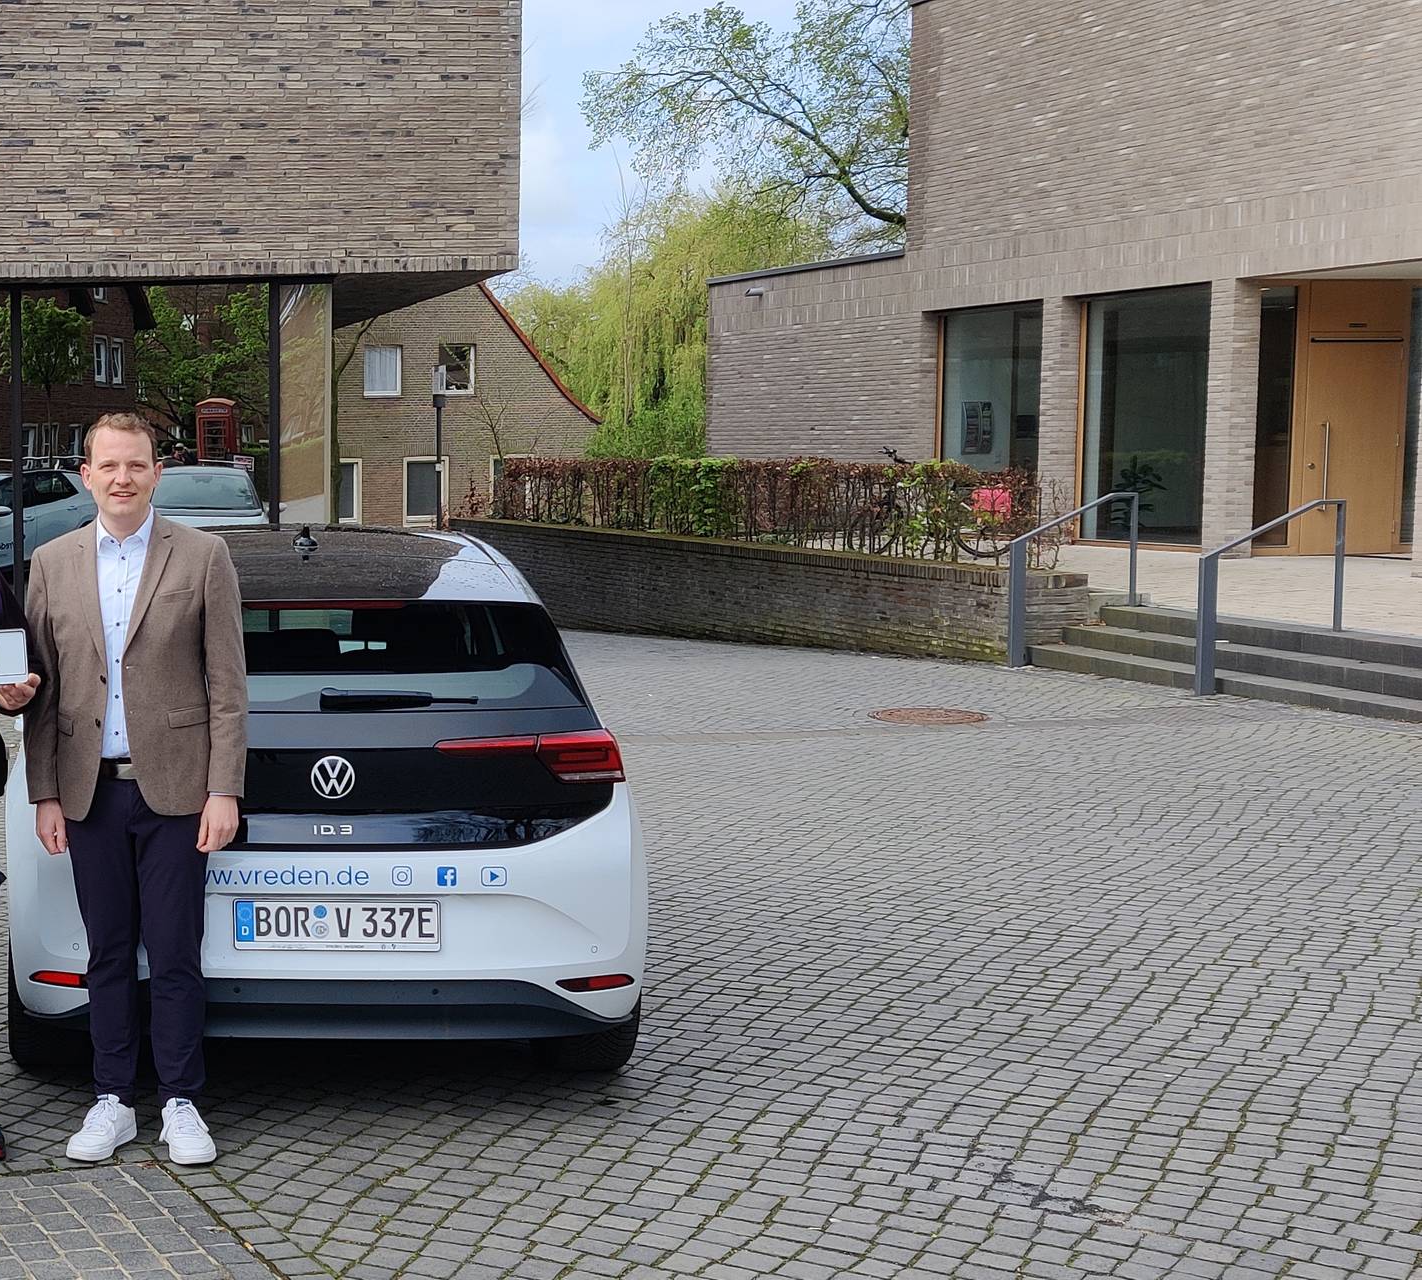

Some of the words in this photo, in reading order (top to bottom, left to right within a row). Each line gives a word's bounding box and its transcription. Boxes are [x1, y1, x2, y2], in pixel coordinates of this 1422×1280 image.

[241, 925, 250, 936] D
[255, 906, 311, 938] BOR
[335, 907, 352, 938] V
[361, 907, 435, 939] 337E
